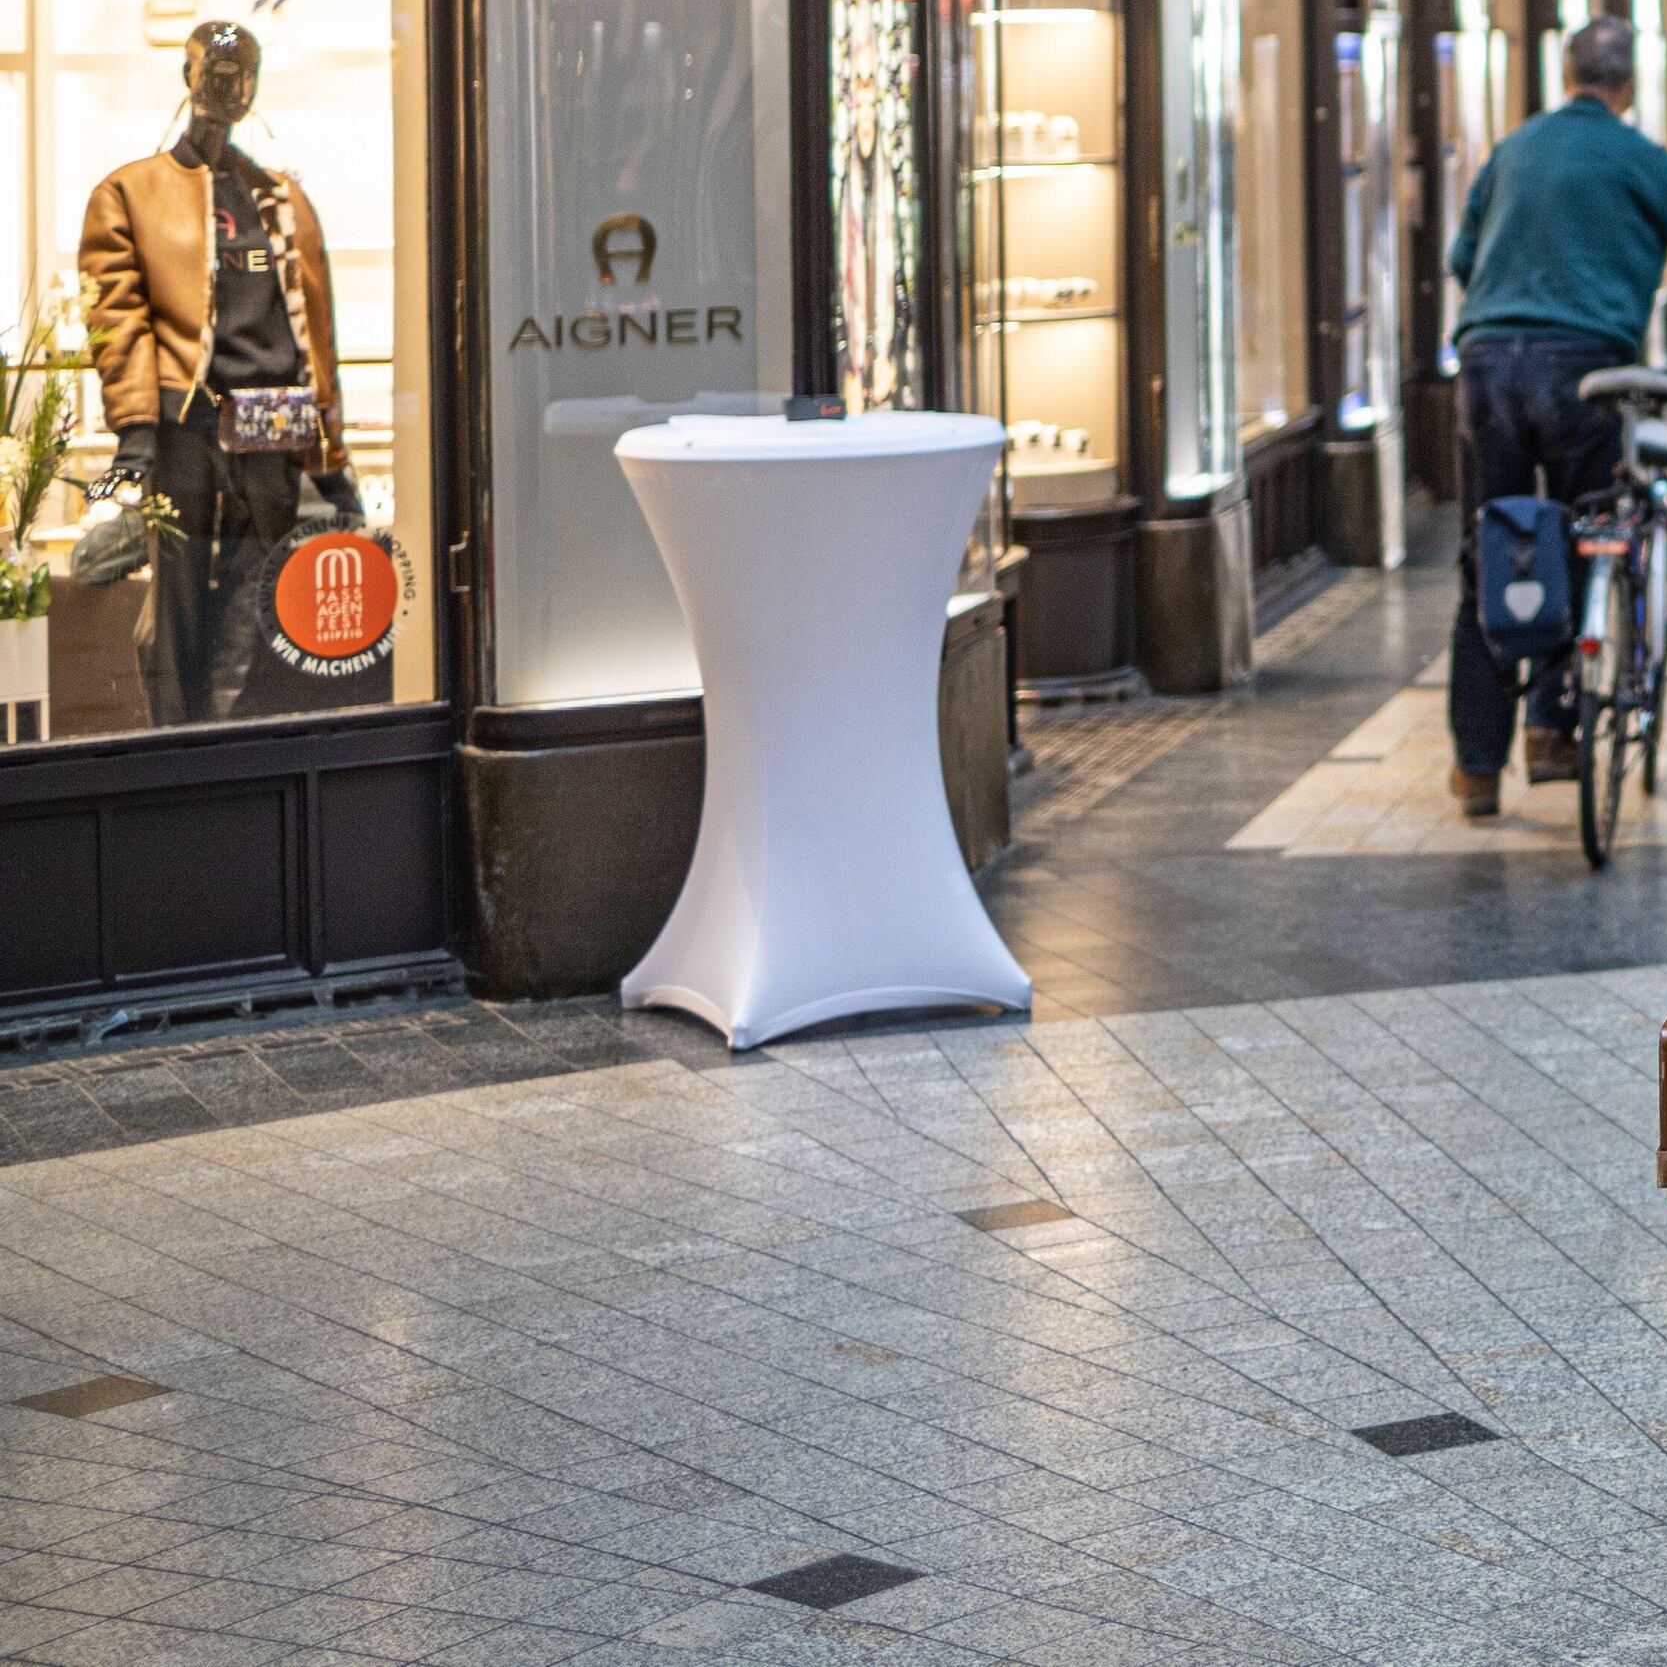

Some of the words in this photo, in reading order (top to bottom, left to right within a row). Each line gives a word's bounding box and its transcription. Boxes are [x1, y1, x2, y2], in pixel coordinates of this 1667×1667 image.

[507, 306, 745, 352] AIGNER
[271, 633, 301, 666] WIR
[301, 651, 376, 677] MACHEN
